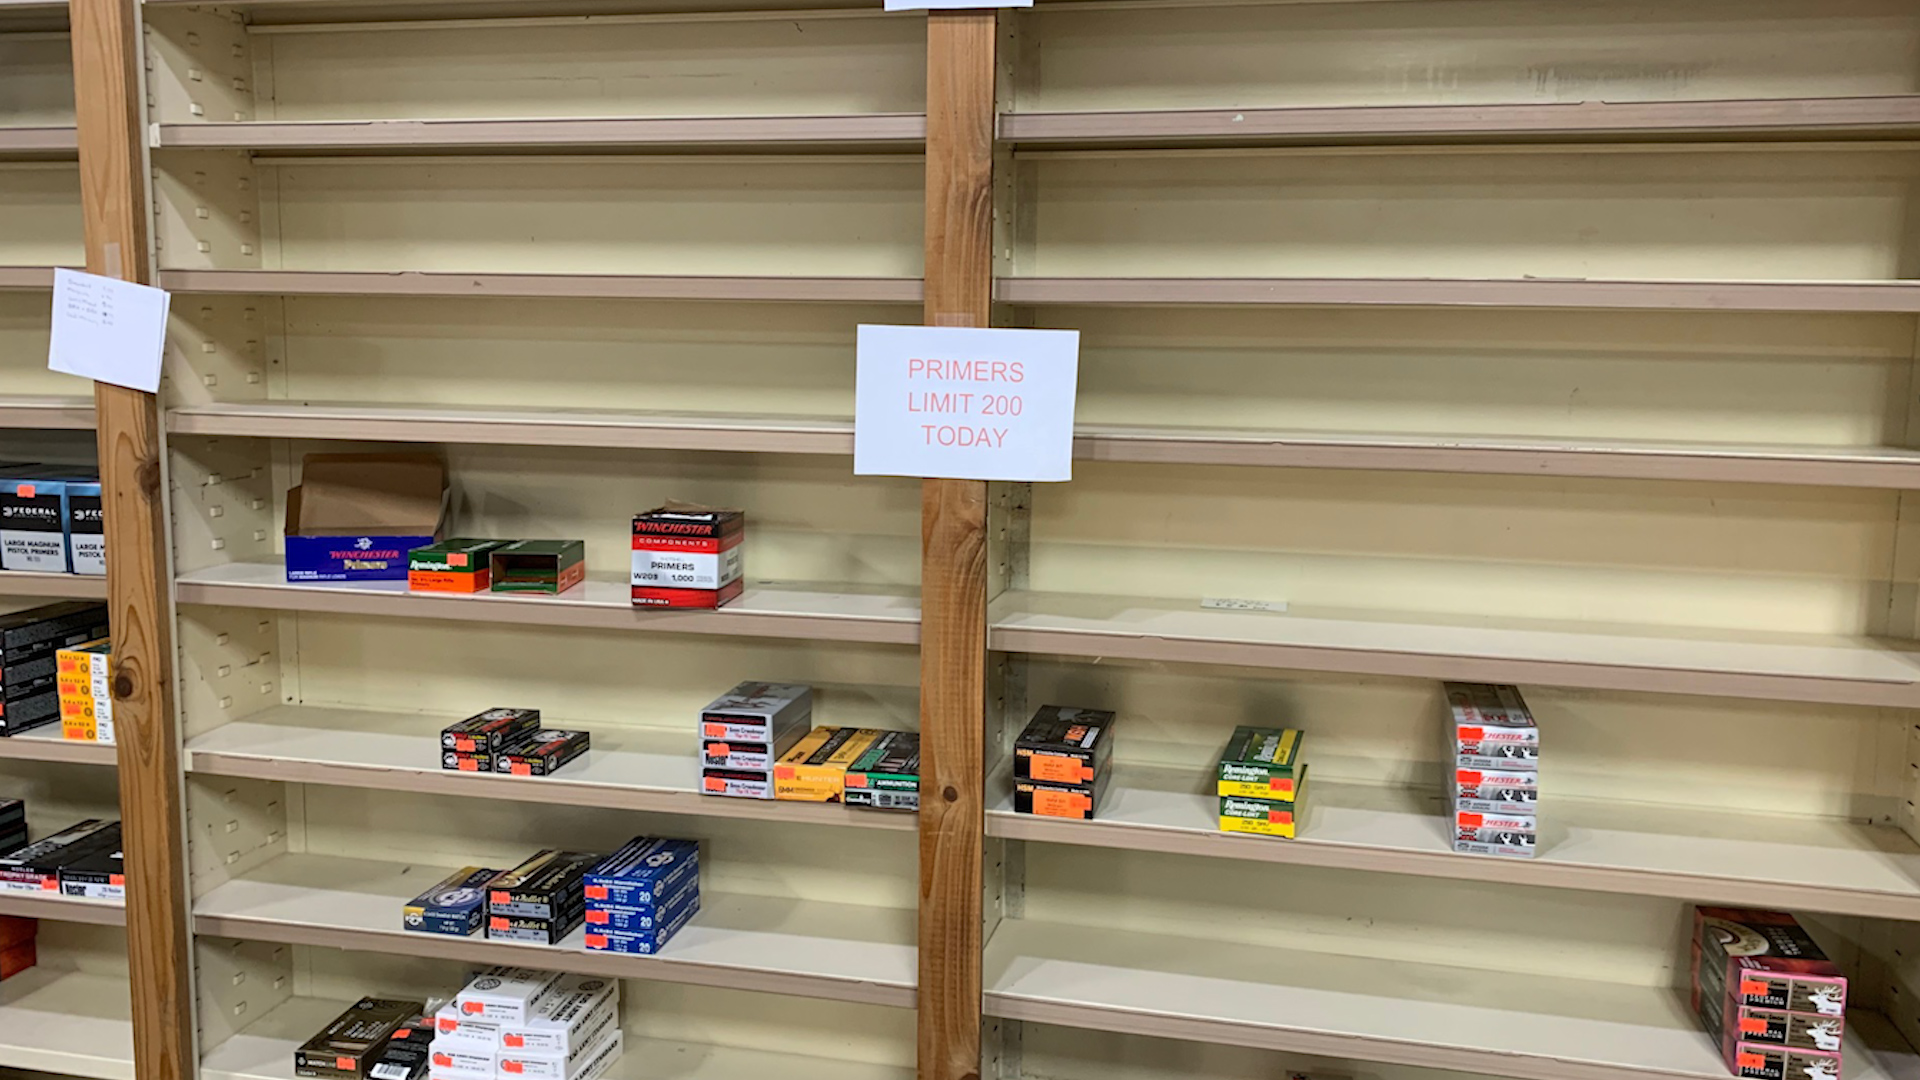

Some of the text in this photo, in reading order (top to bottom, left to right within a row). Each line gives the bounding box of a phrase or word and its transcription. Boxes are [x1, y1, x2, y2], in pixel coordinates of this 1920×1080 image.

[908, 359, 1024, 383] PRIMERS
[908, 392, 1022, 416] LIMIT 200
[921, 425, 1009, 448] TODAY
[13, 507, 57, 517] FEDERAL
[634, 521, 712, 535] WINCHESTER
[639, 538, 708, 547] COMPONENTS
[7, 547, 59, 556] PISTOL PRIMERS
[329, 550, 399, 559] WINCHESTER
[410, 560, 453, 571] Remington
[651, 561, 694, 571] PRIMERS
[1484, 732, 1523, 741] CHESTER
[1223, 763, 1270, 776] Remington
[877, 780, 917, 788] AMMUNITION
[1482, 775, 1522, 784] CHESTER
[1224, 799, 1270, 812] Remington
[639, 891, 651, 902] 20
[640, 916, 652, 927] 20
[639, 942, 651, 954] 20
